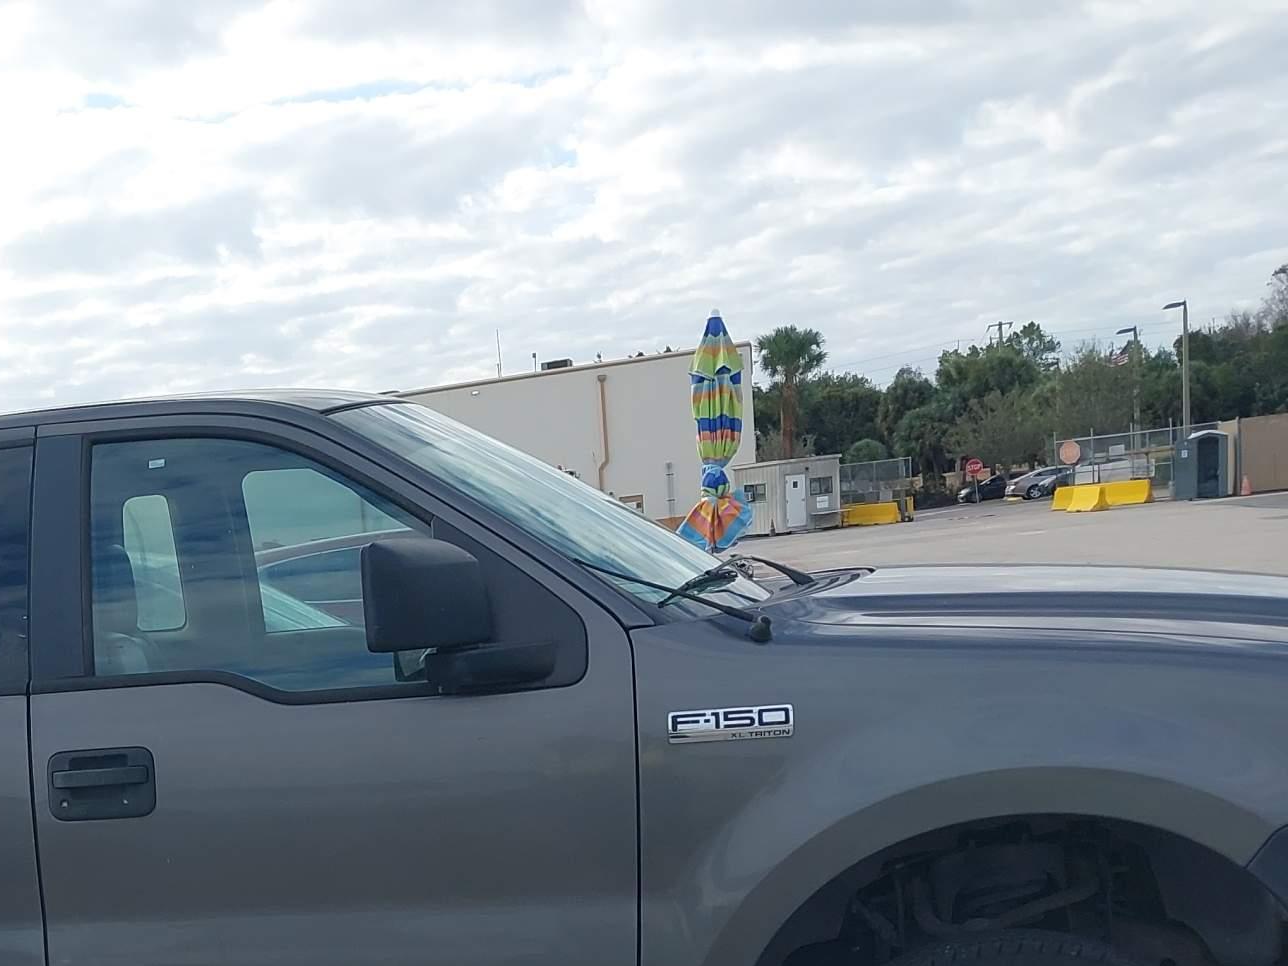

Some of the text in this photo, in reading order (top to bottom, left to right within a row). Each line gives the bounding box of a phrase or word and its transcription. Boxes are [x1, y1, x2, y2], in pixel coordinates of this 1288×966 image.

[670, 706, 791, 733] F-150
[730, 728, 791, 739] XL TRITON
